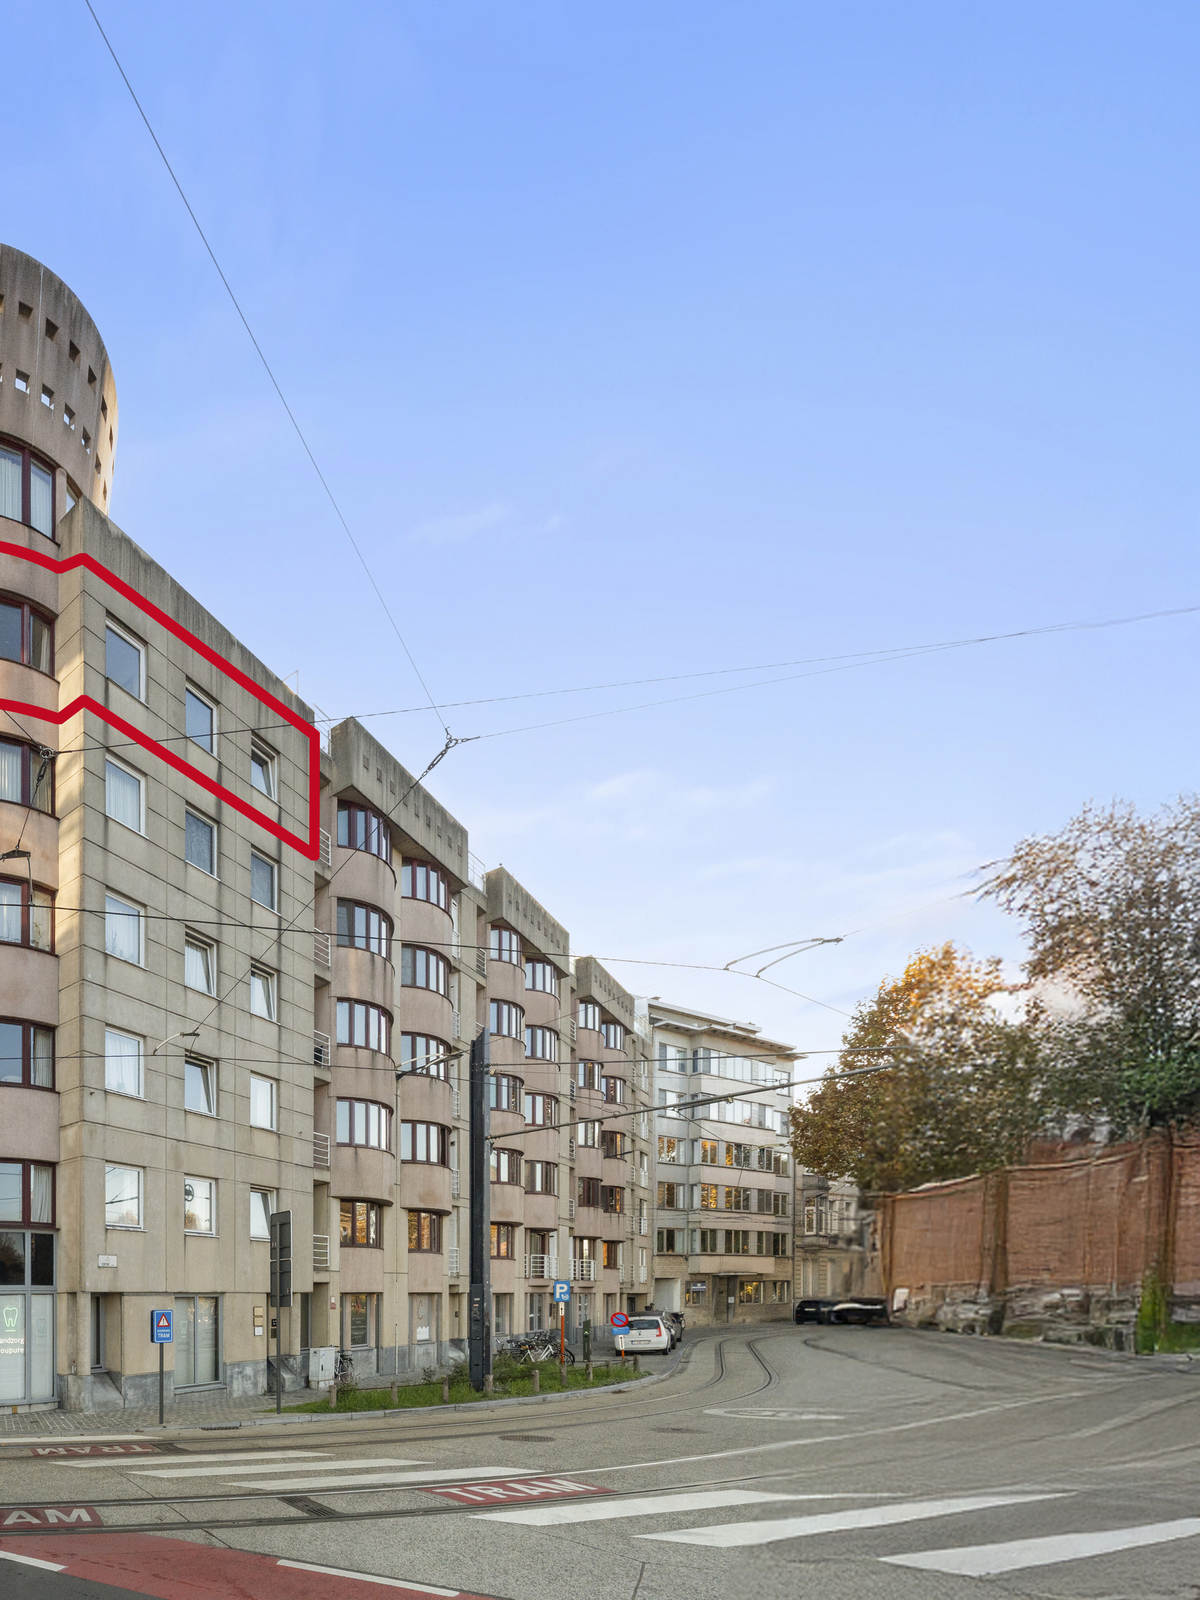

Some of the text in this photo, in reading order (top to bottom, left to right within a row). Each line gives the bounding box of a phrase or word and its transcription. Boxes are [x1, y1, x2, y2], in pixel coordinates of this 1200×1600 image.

[556, 1284, 568, 1298] P
[36, 1444, 152, 1455] TRAM
[432, 1478, 598, 1501] TRAM
